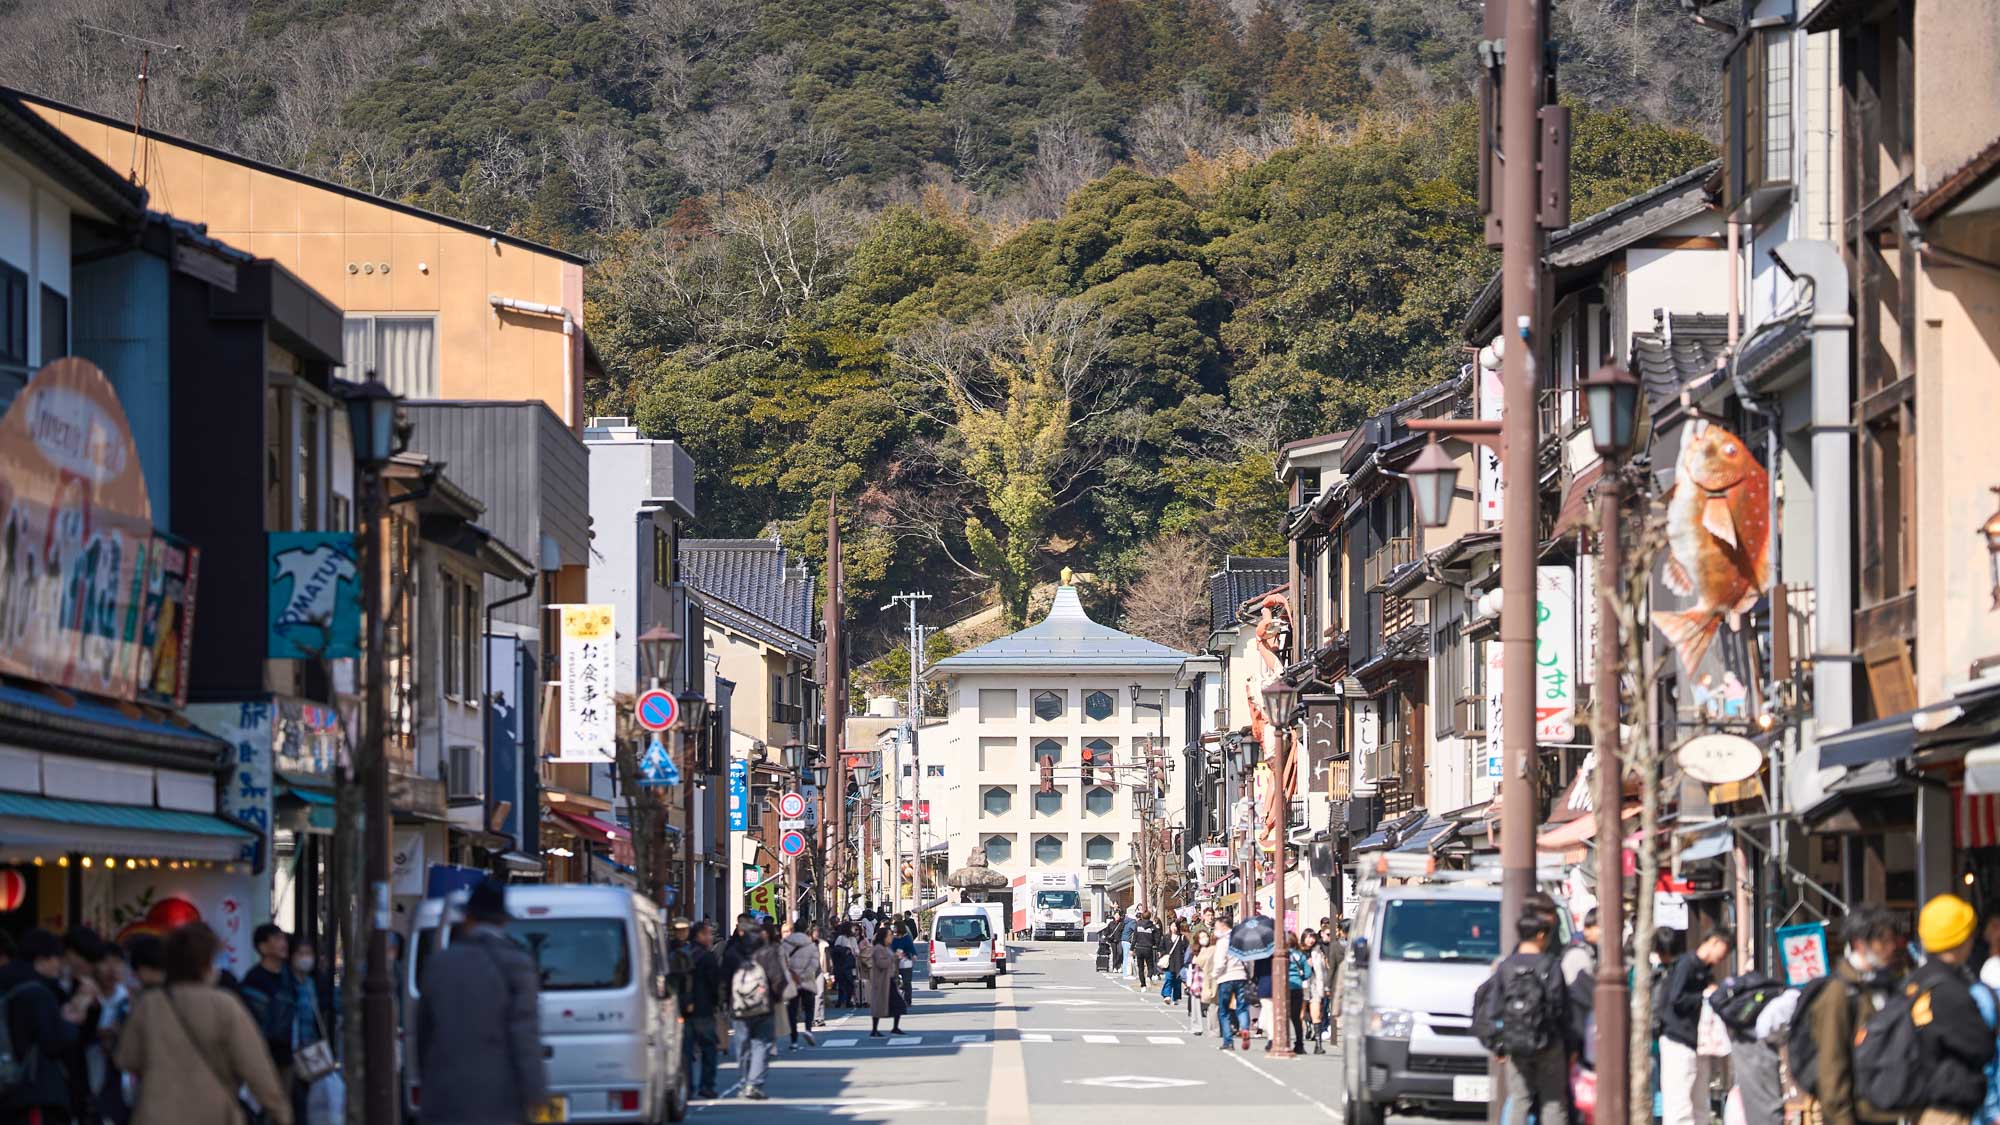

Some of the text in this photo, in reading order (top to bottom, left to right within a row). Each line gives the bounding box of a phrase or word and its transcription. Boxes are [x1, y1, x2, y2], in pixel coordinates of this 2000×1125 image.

[579, 643, 599, 727] お食事処
[785, 800, 800, 812] 30
